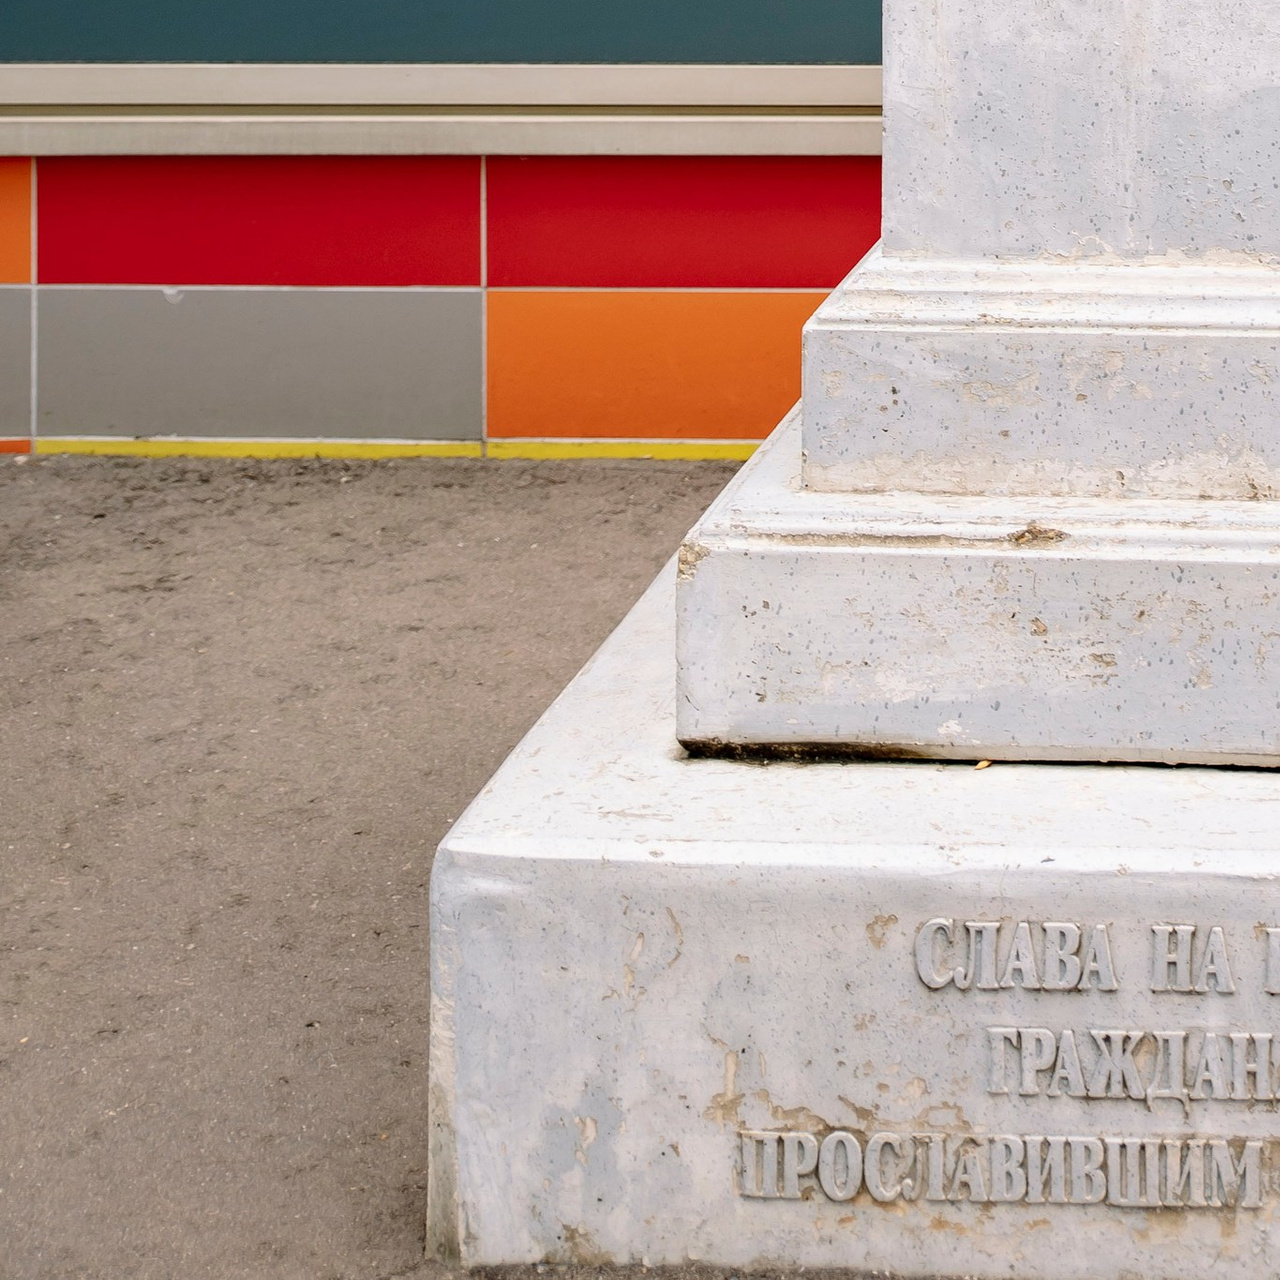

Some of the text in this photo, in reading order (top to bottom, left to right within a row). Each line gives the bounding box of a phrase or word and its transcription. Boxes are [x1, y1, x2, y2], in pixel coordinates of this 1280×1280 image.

[916, 918, 1117, 994] СЛАВА
[1151, 924, 1235, 996] НА
[739, 1129, 1264, 1211] ПРОСЛАВИВШИМ
